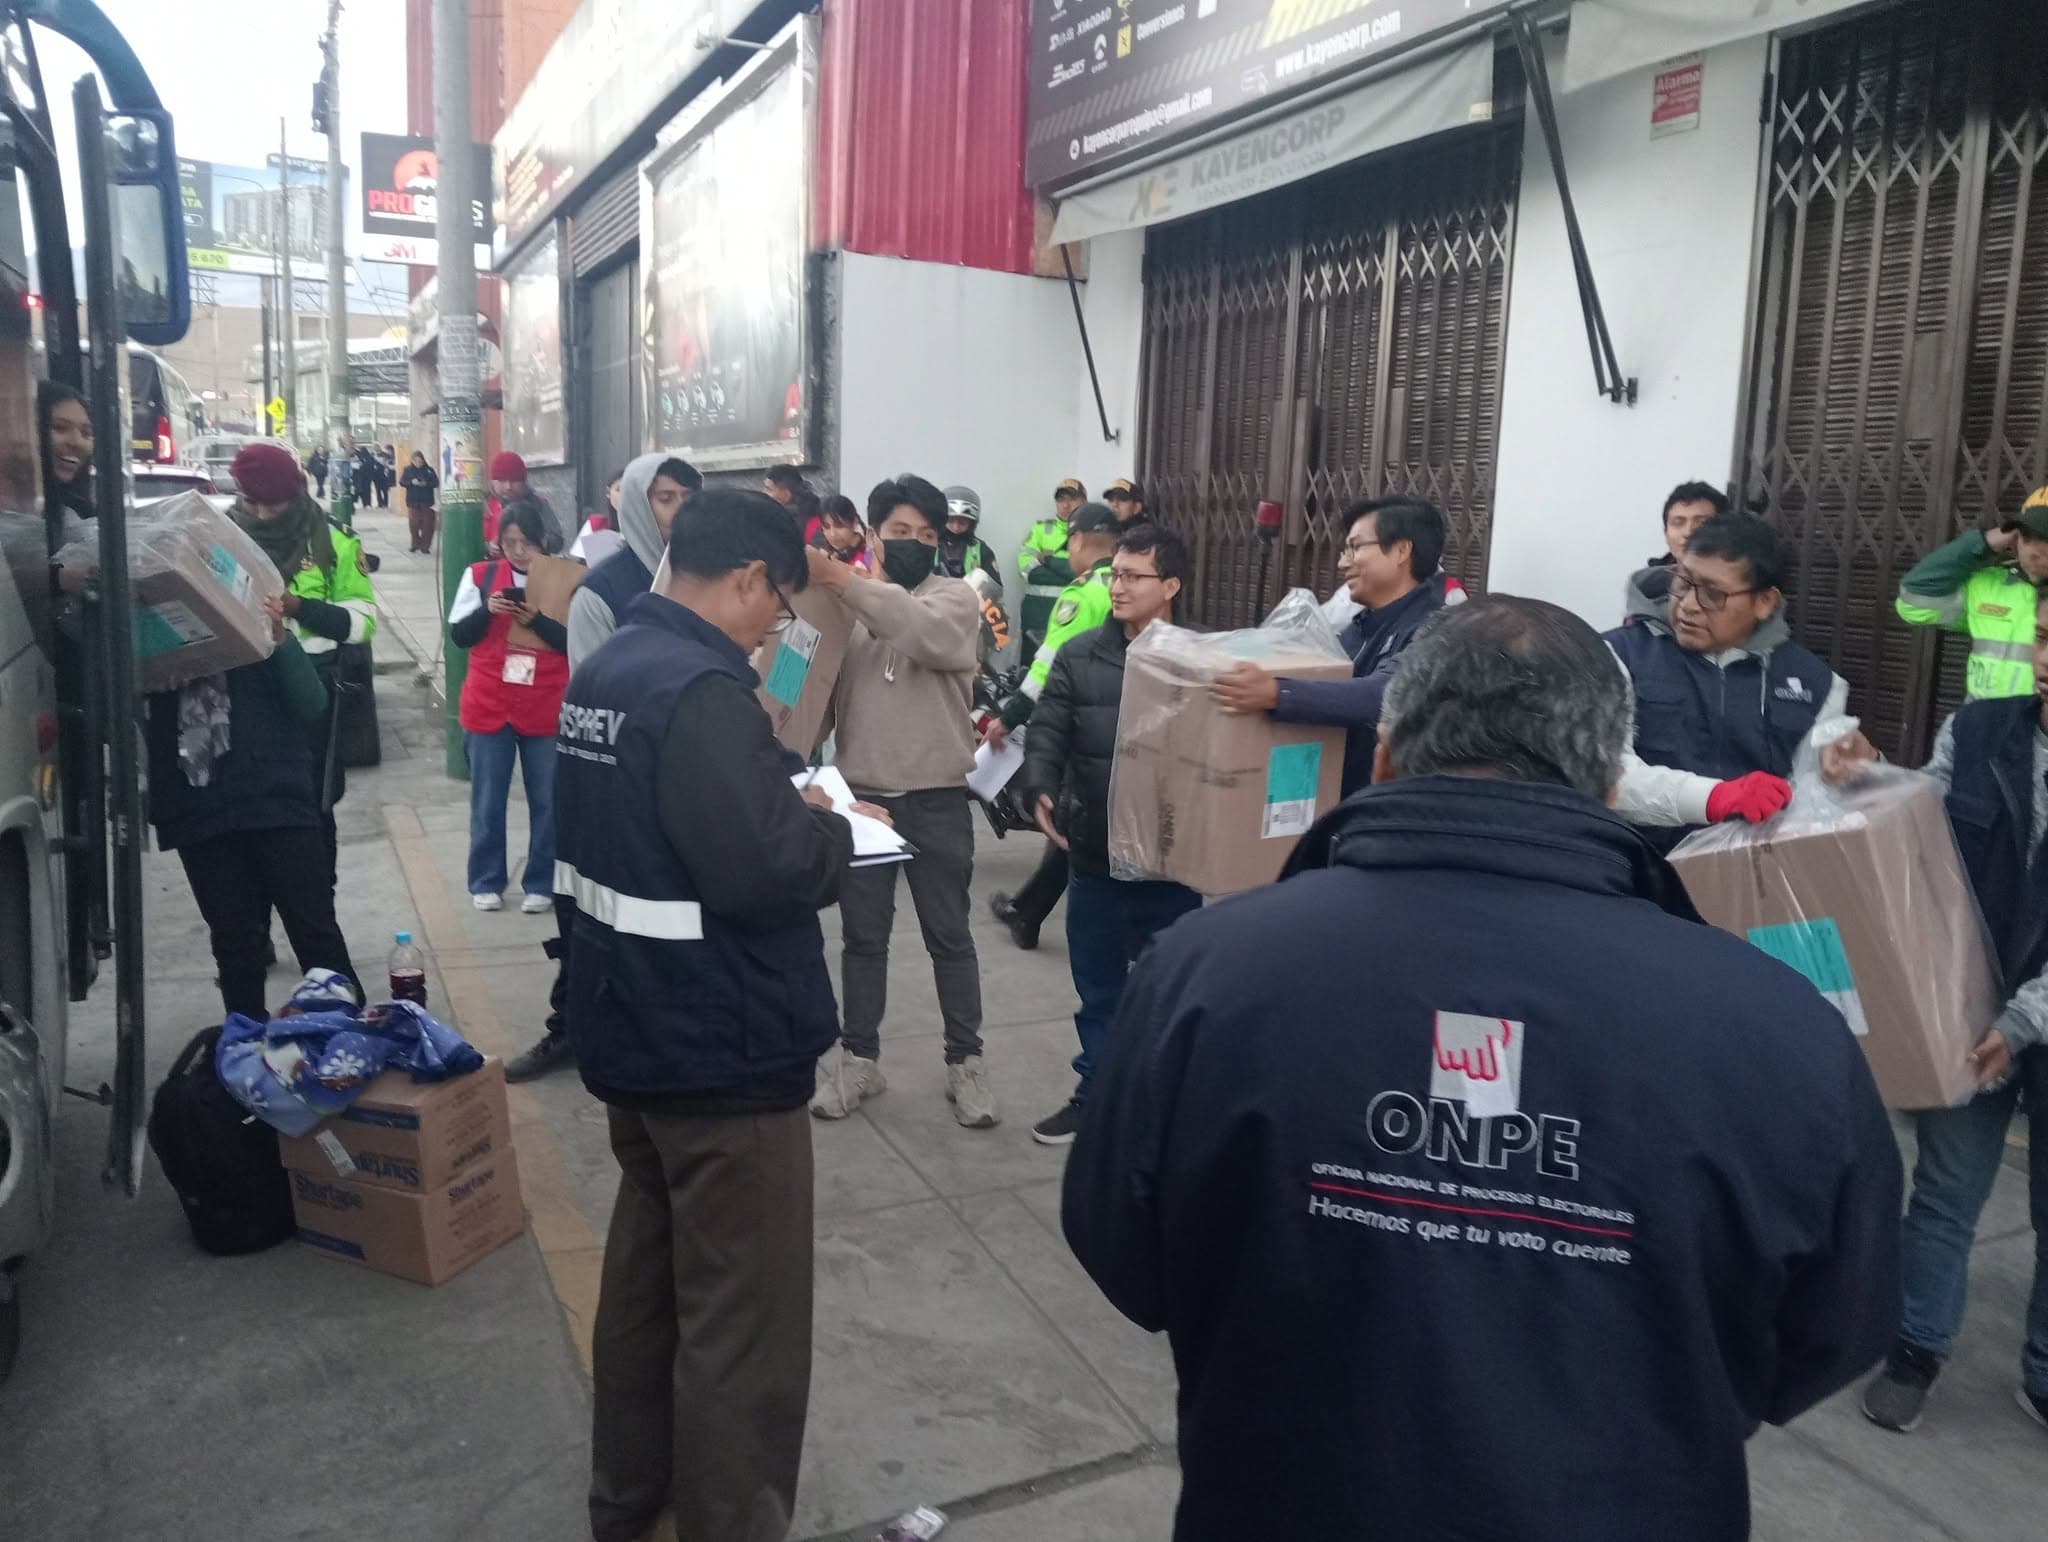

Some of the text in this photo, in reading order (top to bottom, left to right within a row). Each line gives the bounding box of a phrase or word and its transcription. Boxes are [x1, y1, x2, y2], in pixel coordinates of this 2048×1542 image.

[1191, 105, 1345, 189] KAYENCORP
[1366, 1090, 1581, 1181] ONPE
[1308, 1195, 1633, 1265] Hacemos que tu voto cuente
[1311, 1162, 1636, 1225] OFICINA NACIONAL DE PROCESOS ELECTORALES
